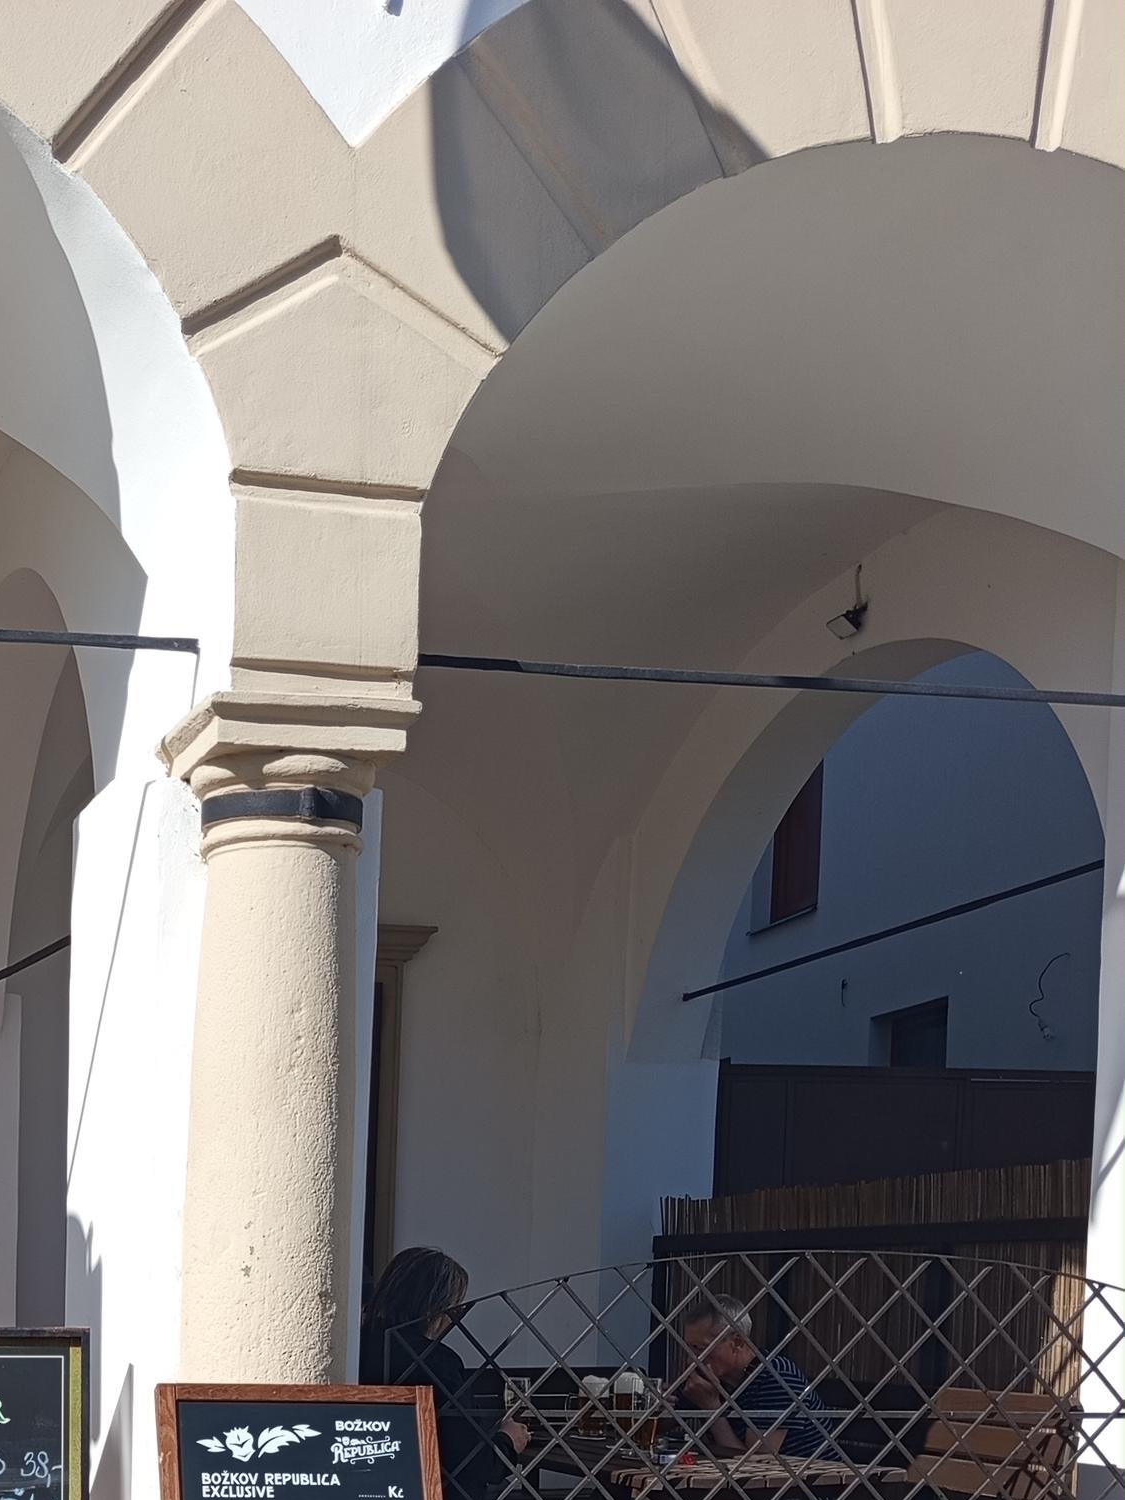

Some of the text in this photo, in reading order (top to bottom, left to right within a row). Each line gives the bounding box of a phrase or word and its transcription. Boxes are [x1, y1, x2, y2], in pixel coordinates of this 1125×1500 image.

[335, 1419, 391, 1432] BOŽKOV
[201, 1470, 341, 1487] BOŽKOV REPUBLICA
[202, 1485, 405, 1499] EXCLUSIVE Kč
